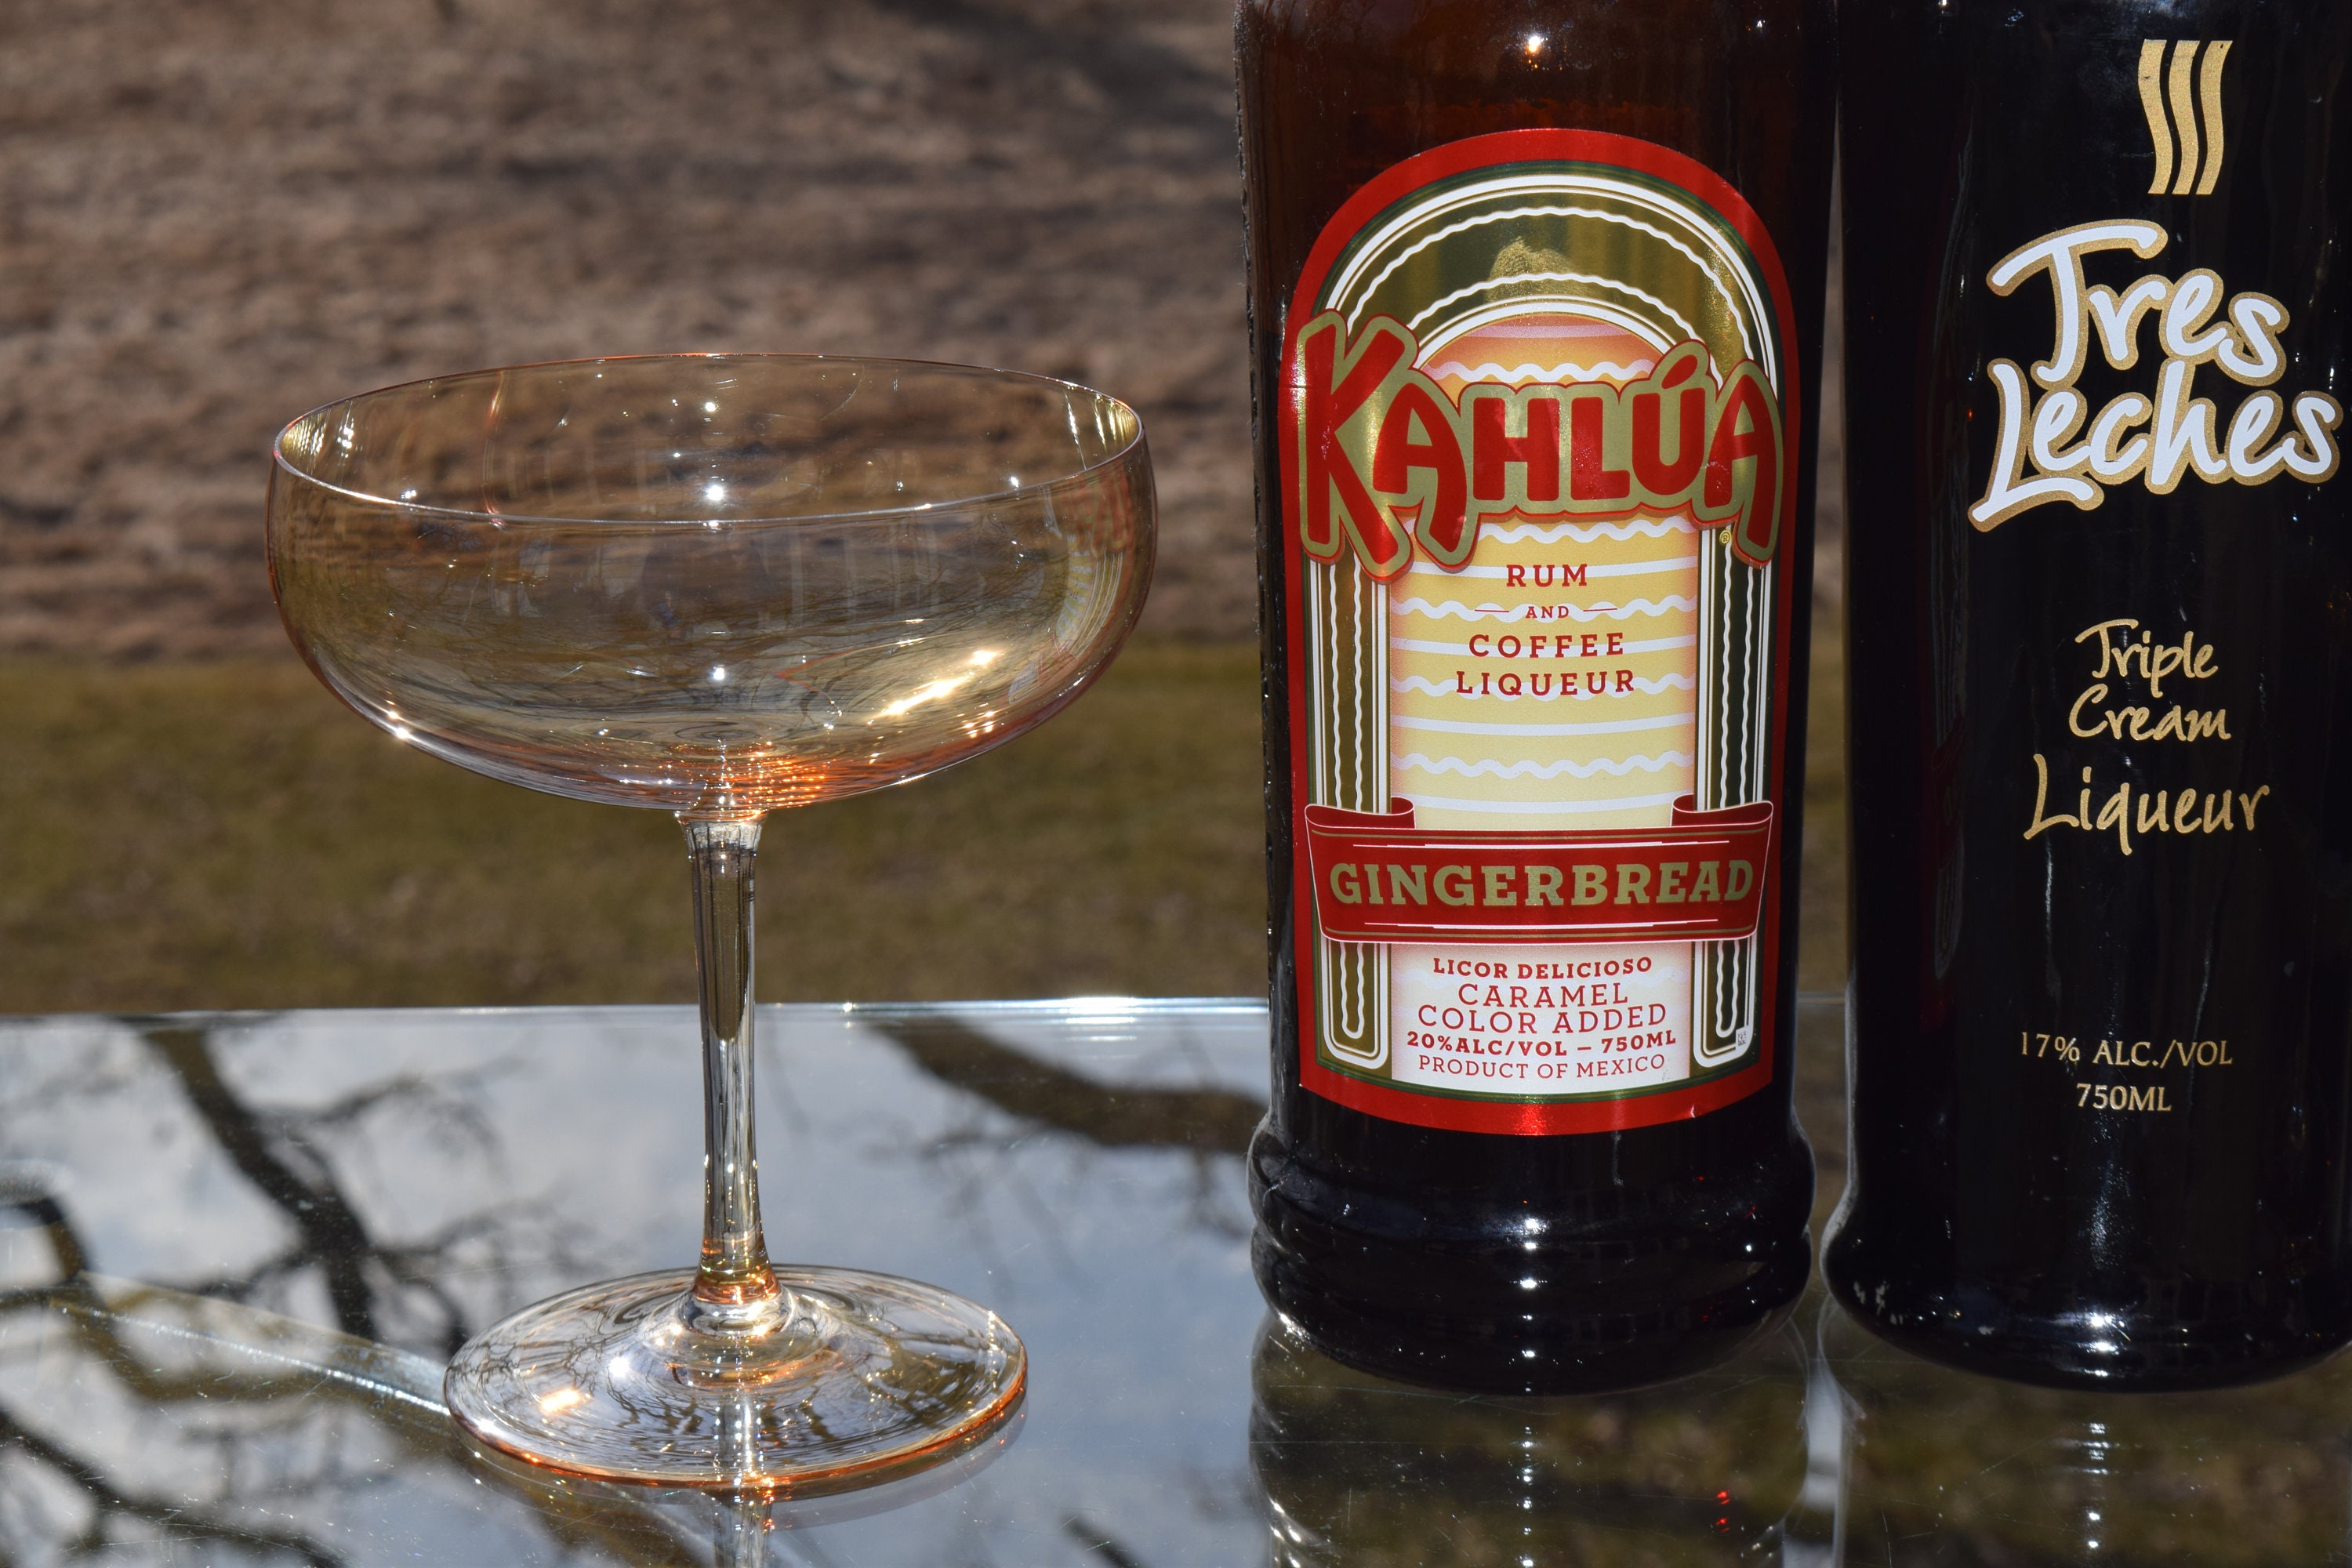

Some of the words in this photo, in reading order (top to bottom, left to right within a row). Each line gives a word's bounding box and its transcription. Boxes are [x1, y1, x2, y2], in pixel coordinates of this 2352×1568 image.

[1987, 219, 2290, 390] Tres
[1298, 308, 1784, 584] KAHLÚA
[1968, 358, 2343, 532] Leches
[1506, 563, 1588, 589] RUM
[1525, 604, 1570, 619] AND
[1468, 632, 1624, 658] COFFEE
[2075, 619, 2219, 698] Triple
[1456, 670, 1635, 696] LIQUEUR
[2068, 684, 2231, 741] Cream
[2024, 753, 2270, 855] Liqueur
[1330, 859, 1754, 907] GINGERBREAD
[1433, 957, 1508, 979] LICOR
[1517, 956, 1652, 979] DELICIOSO
[1458, 982, 1628, 1008] CARAMEL
[1418, 1004, 1537, 1034] COLOR
[1552, 1003, 1666, 1033] ADDED
[1406, 1031, 1567, 1057] 20%ALC/VOL
[1601, 1029, 1676, 1054] 750ML
[2021, 1032, 2081, 1062] 17%
[2092, 1040, 2232, 1068] ALC./VOL
[1419, 1054, 1528, 1079] PRODUCT
[1537, 1063, 1568, 1079] OF
[1577, 1054, 1665, 1078] MEXICO
[2077, 1083, 2172, 1112] 750ML
